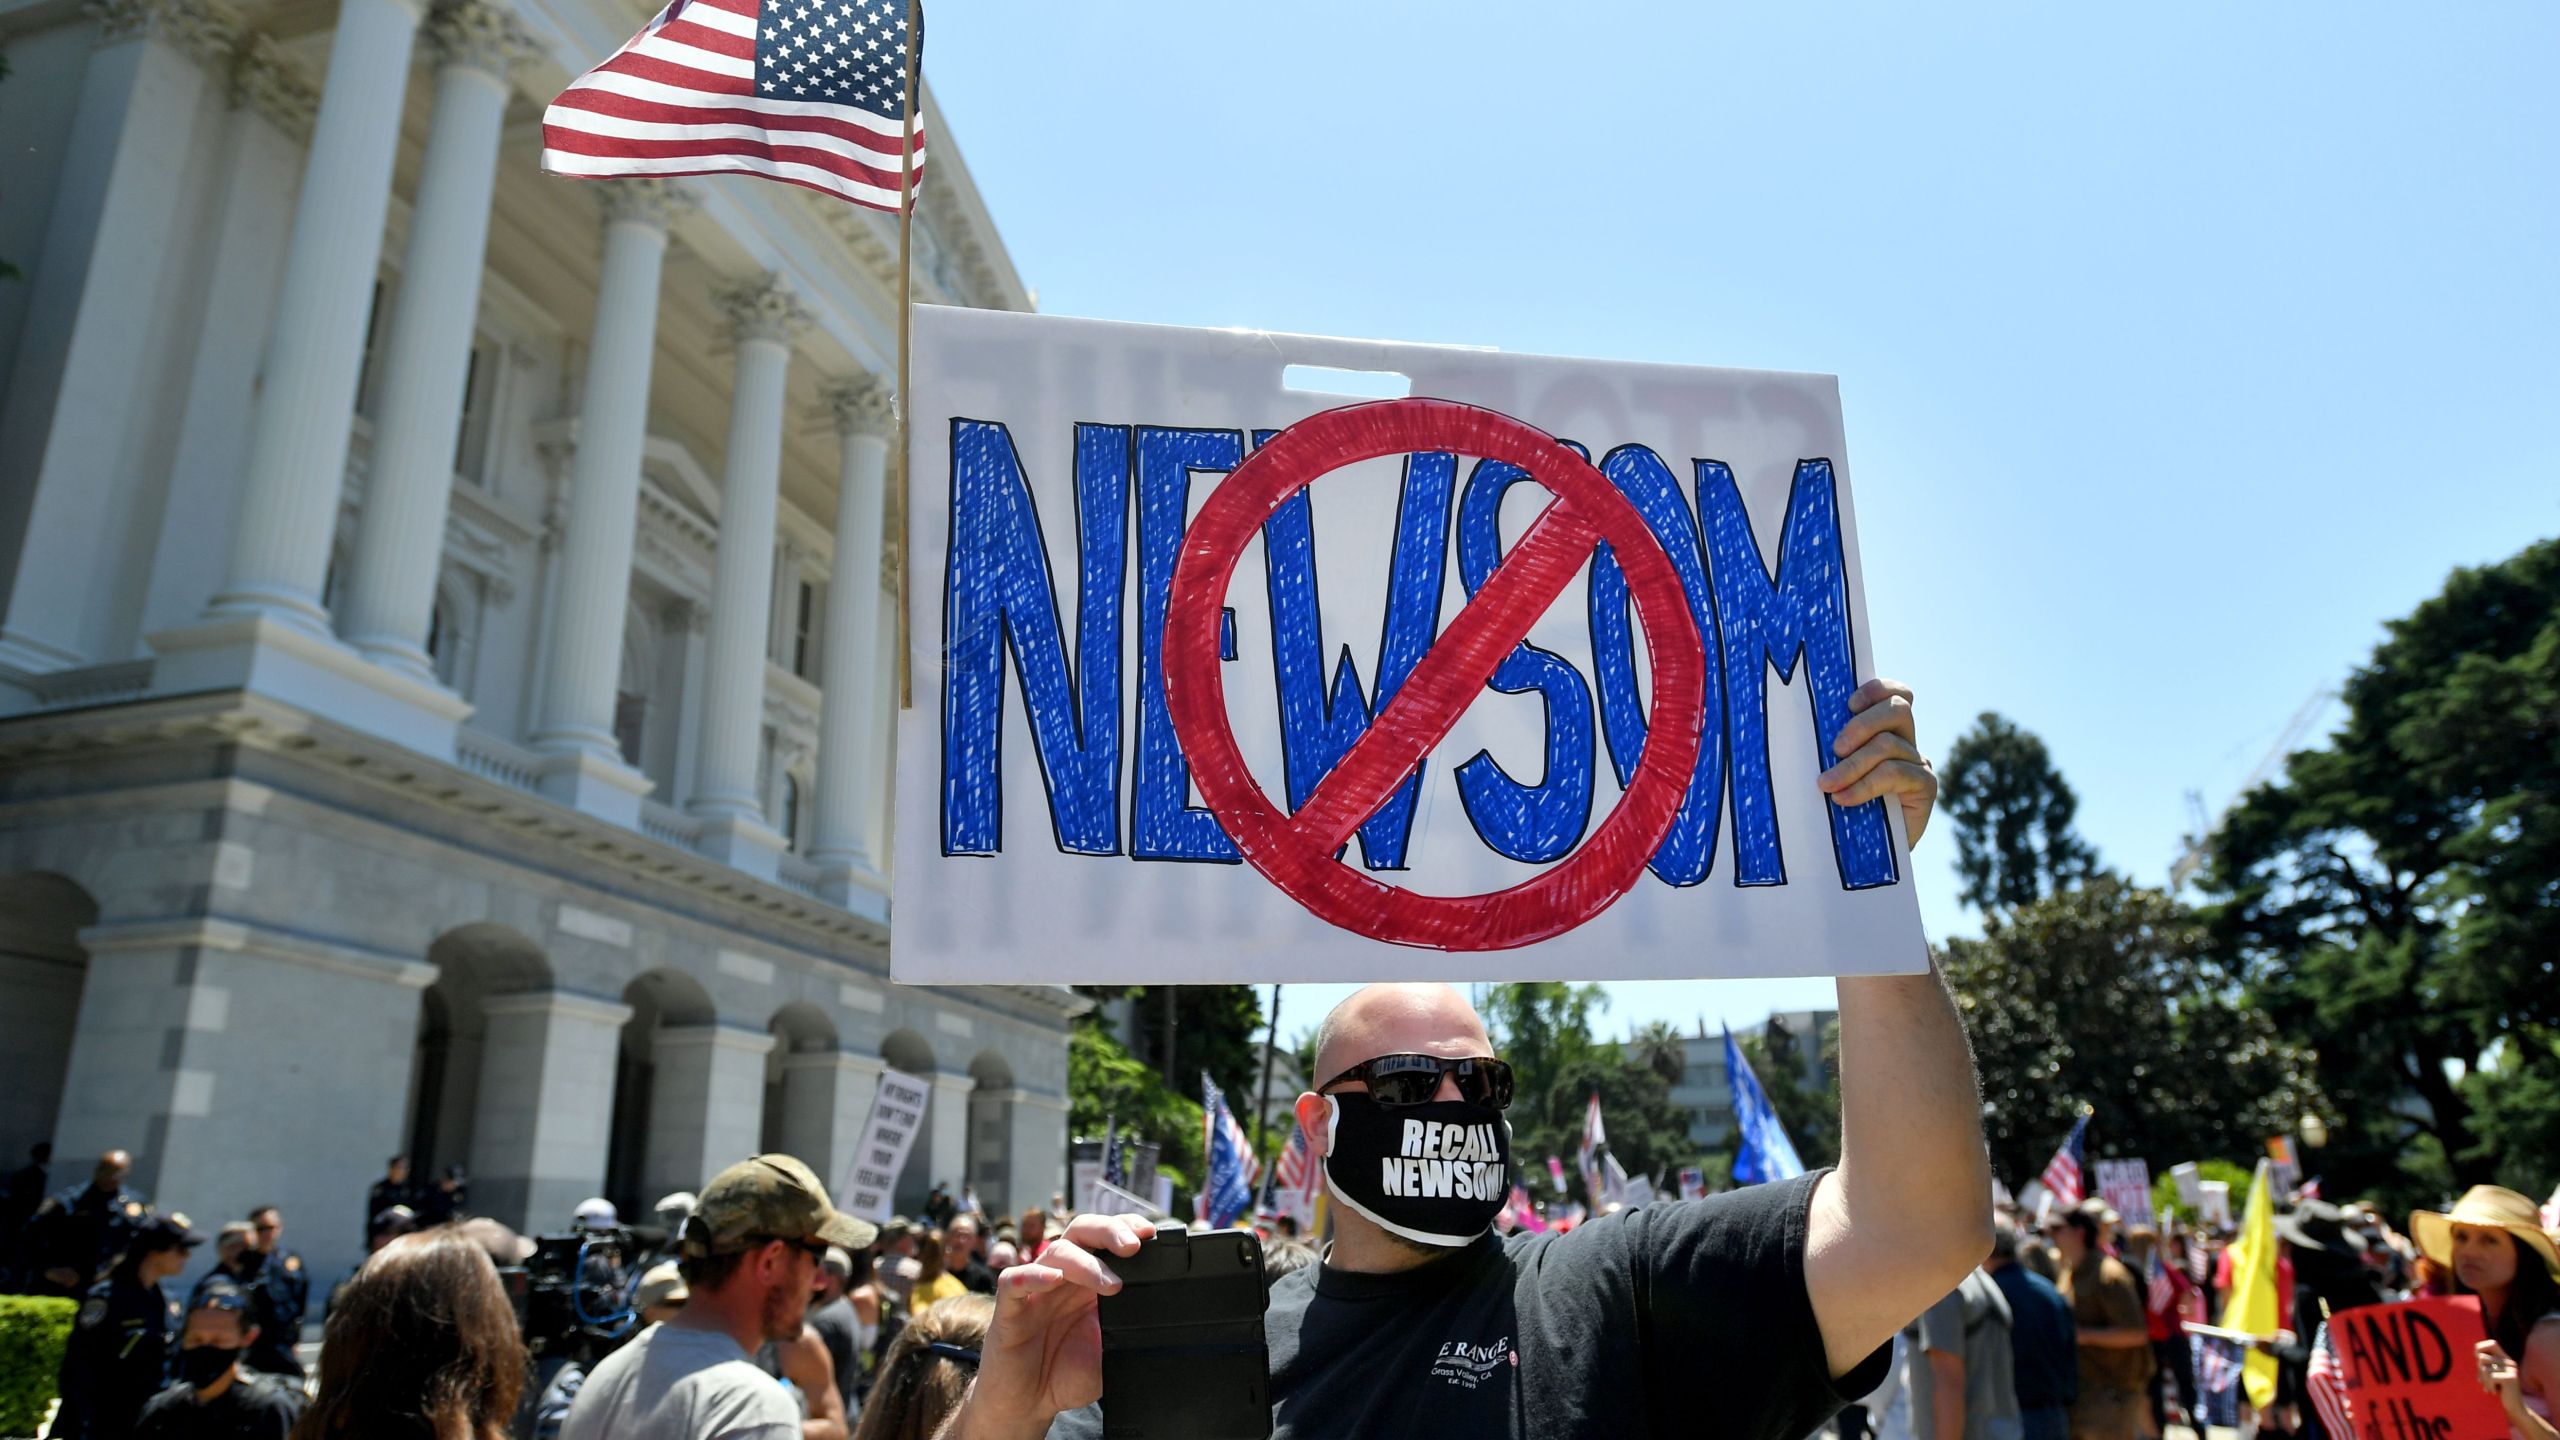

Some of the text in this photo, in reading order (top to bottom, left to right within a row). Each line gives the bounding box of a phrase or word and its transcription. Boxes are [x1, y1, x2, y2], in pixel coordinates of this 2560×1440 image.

[940, 415, 1899, 890] NEWSOM
[1400, 1118, 1500, 1163] RECALL
[1454, 1336, 1508, 1363] RANGE
[2347, 1309, 2453, 1389] AND
[1431, 1367, 1492, 1383] Grass Valley, CA
